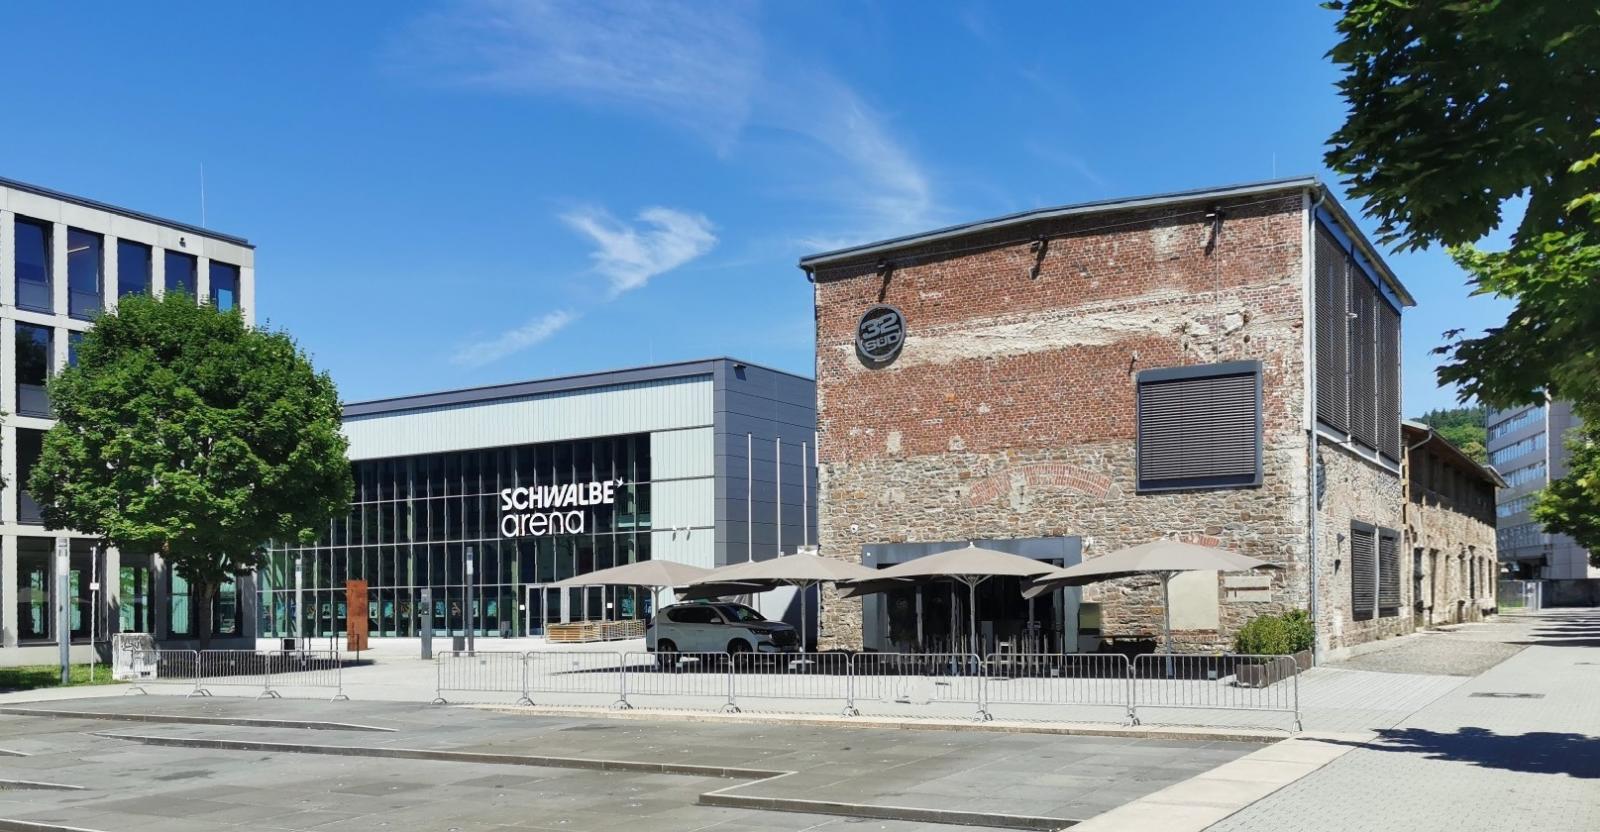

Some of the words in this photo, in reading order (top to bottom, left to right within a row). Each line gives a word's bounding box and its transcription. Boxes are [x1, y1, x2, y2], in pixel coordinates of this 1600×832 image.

[861, 312, 900, 340] 32
[500, 480, 615, 511] SCHWALBE
[501, 510, 585, 538] arena
